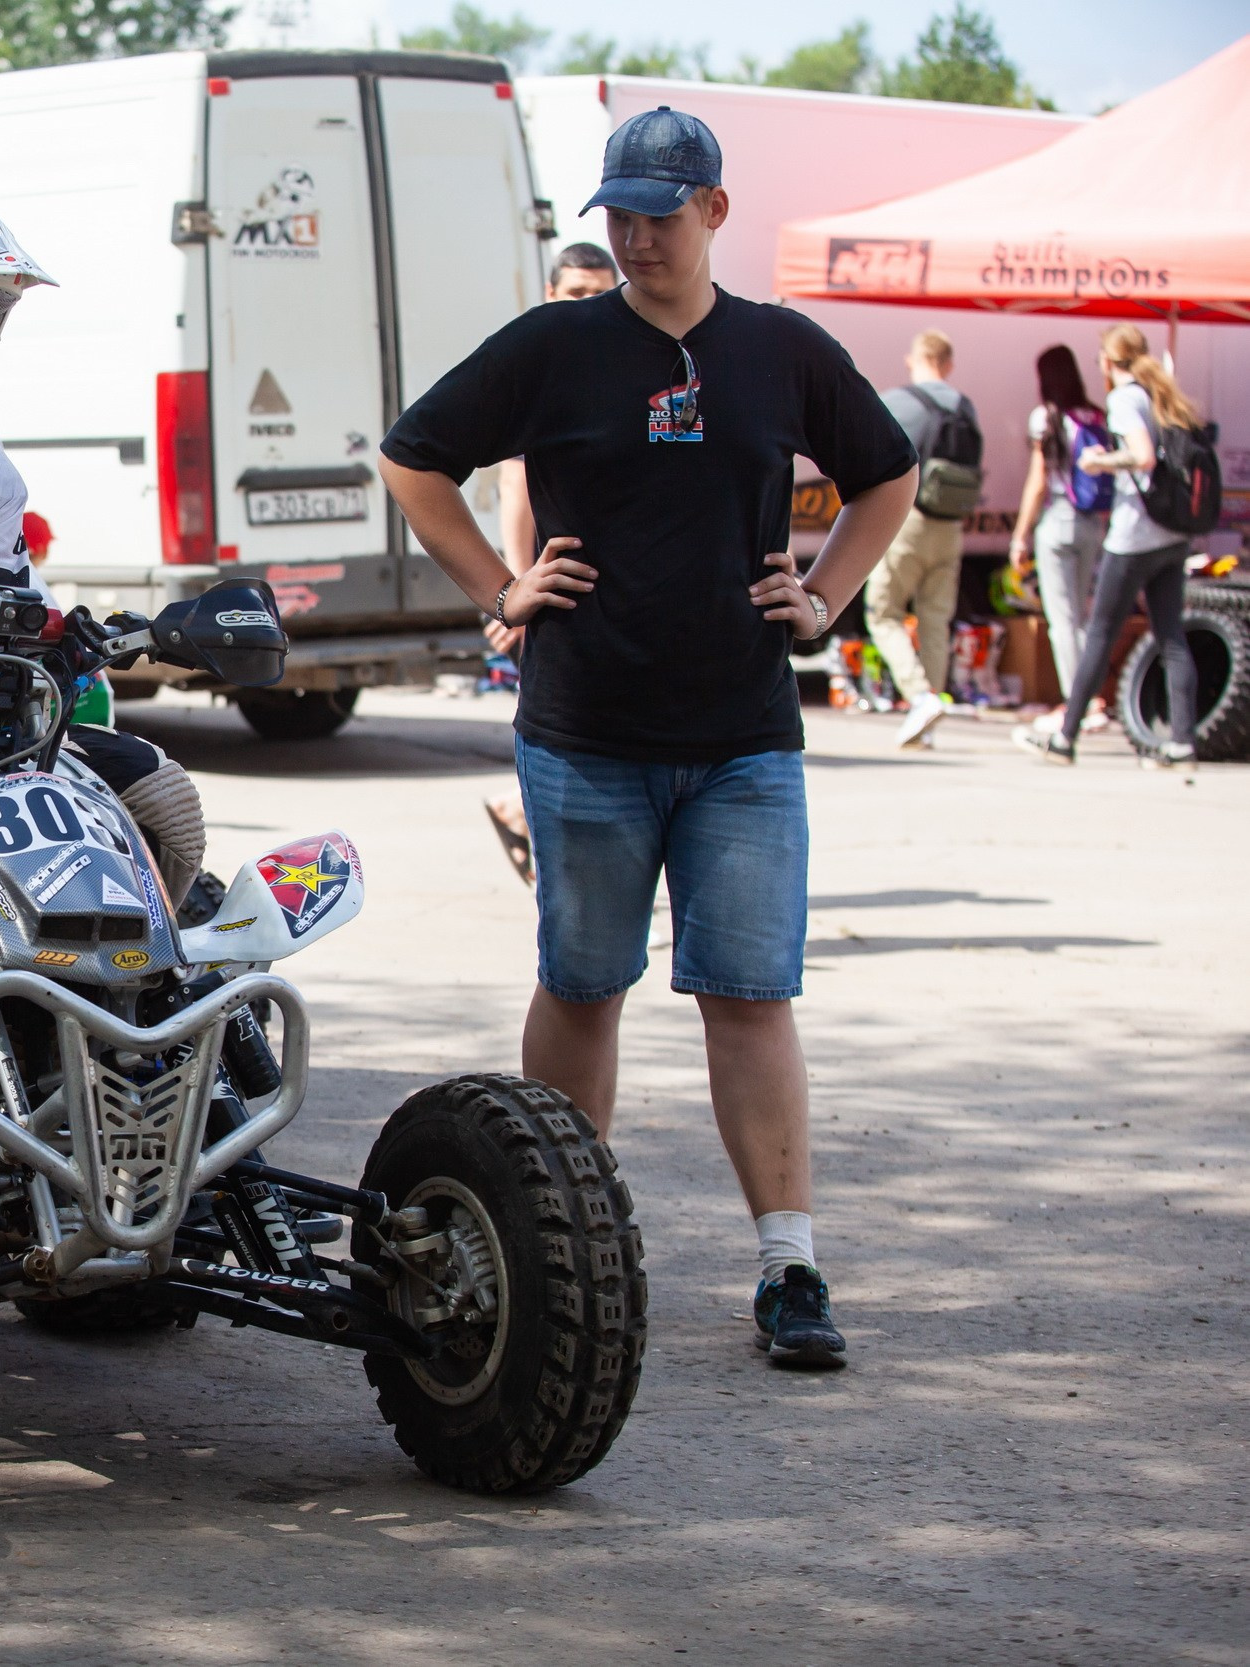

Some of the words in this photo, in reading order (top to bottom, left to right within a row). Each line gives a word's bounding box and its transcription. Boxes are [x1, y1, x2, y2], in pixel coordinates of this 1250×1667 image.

[26, 840, 85, 892] alpinestars
[37, 854, 92, 905] WISECO
[294, 884, 344, 933] alpinestars
[117, 952, 144, 966] Arai
[224, 1213, 242, 1240] EXTRA
[207, 1263, 330, 1292] HOUSER
